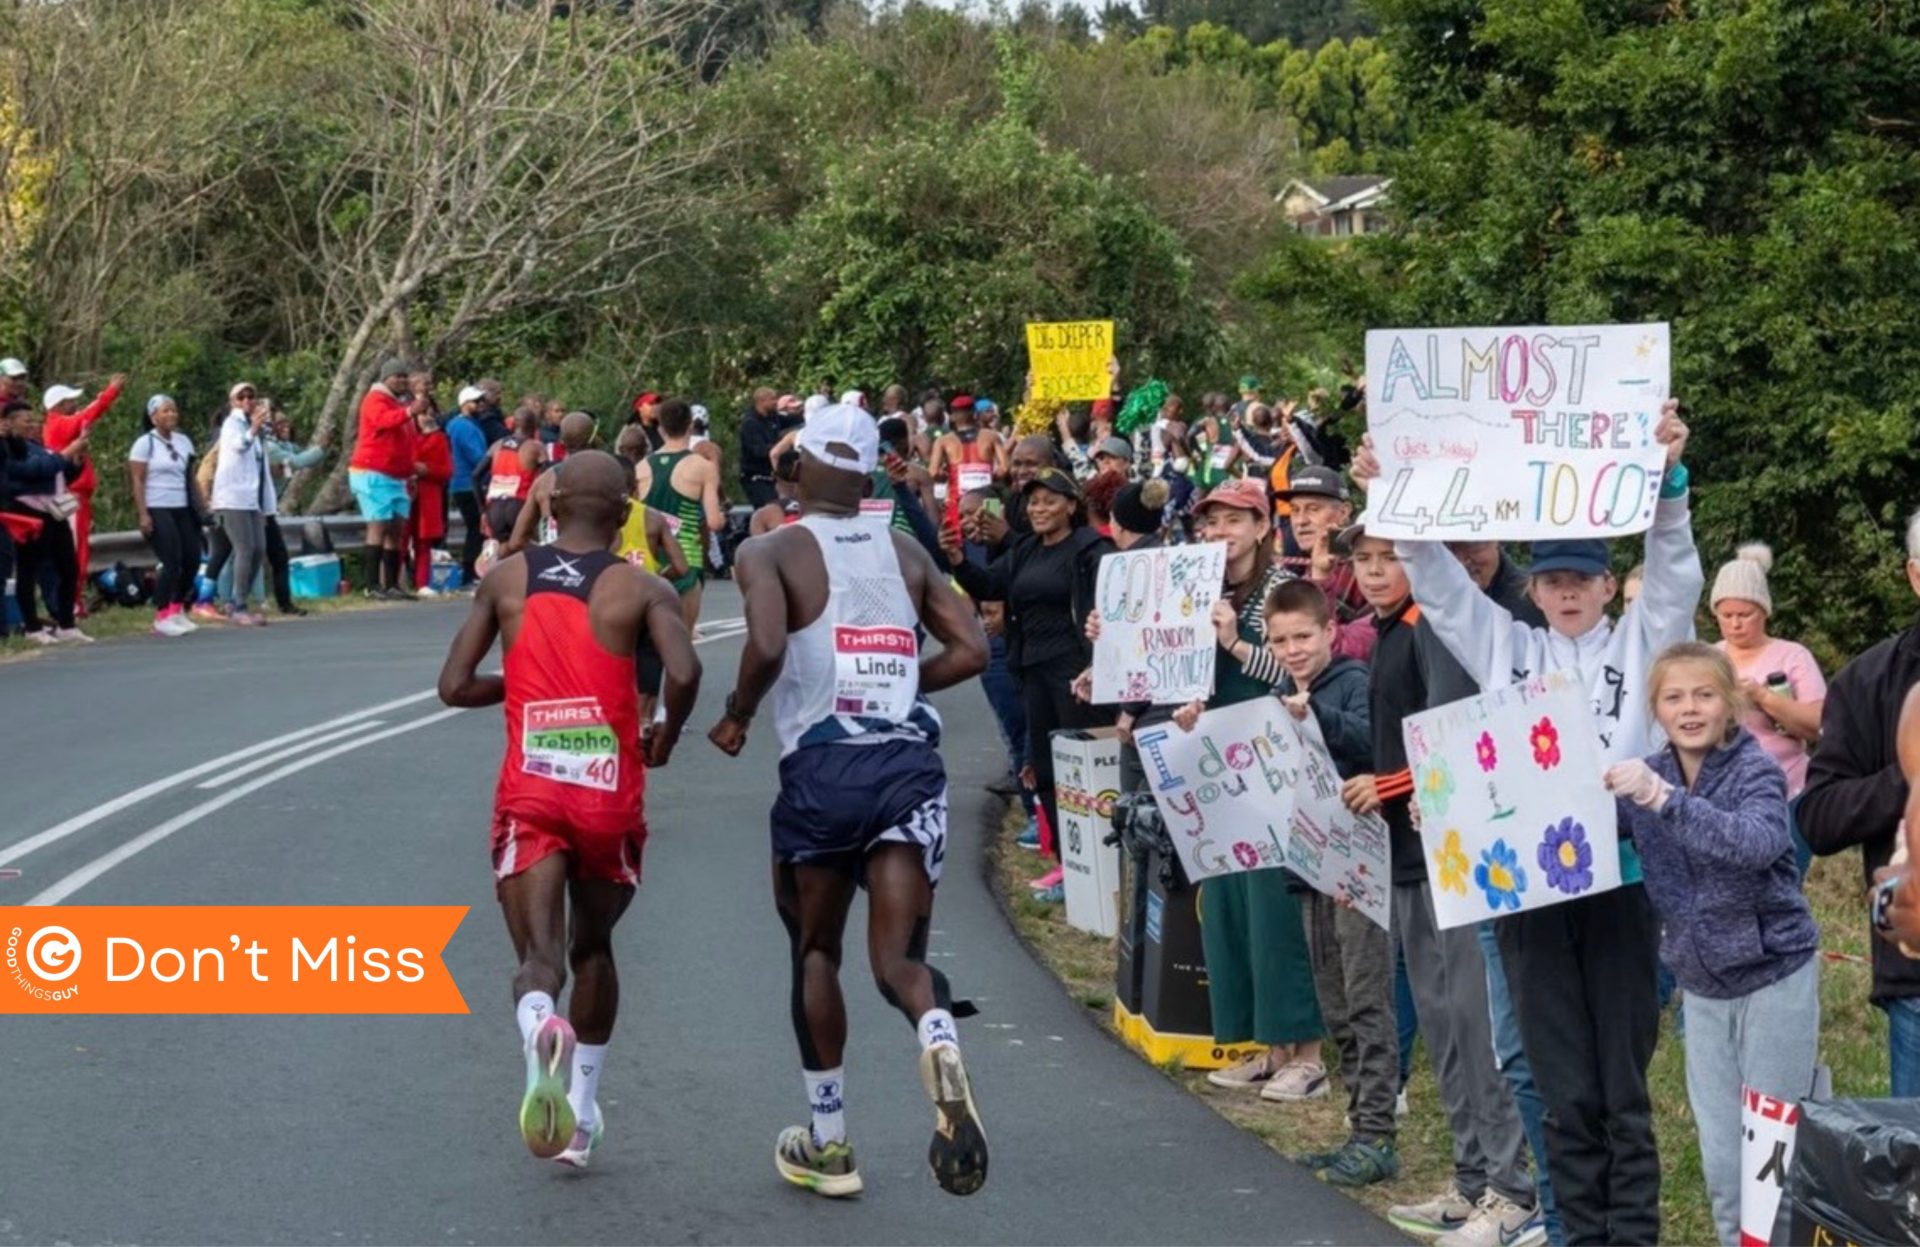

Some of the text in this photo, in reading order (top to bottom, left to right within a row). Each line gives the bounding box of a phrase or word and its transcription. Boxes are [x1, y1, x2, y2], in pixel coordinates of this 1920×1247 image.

[1057, 323, 1106, 350] DEEPER
[1382, 333, 1601, 406] ALMOST
[1378, 467, 1488, 535] 44
[1496, 500, 1520, 521] KM
[1528, 460, 1579, 527] TO
[1102, 550, 1169, 624] GO!
[1141, 626, 1196, 652] RANDOM
[855, 656, 907, 678] Linda
[586, 756, 616, 784] 40
[1093, 756, 1121, 767] PLE
[1167, 773, 1249, 838] you
